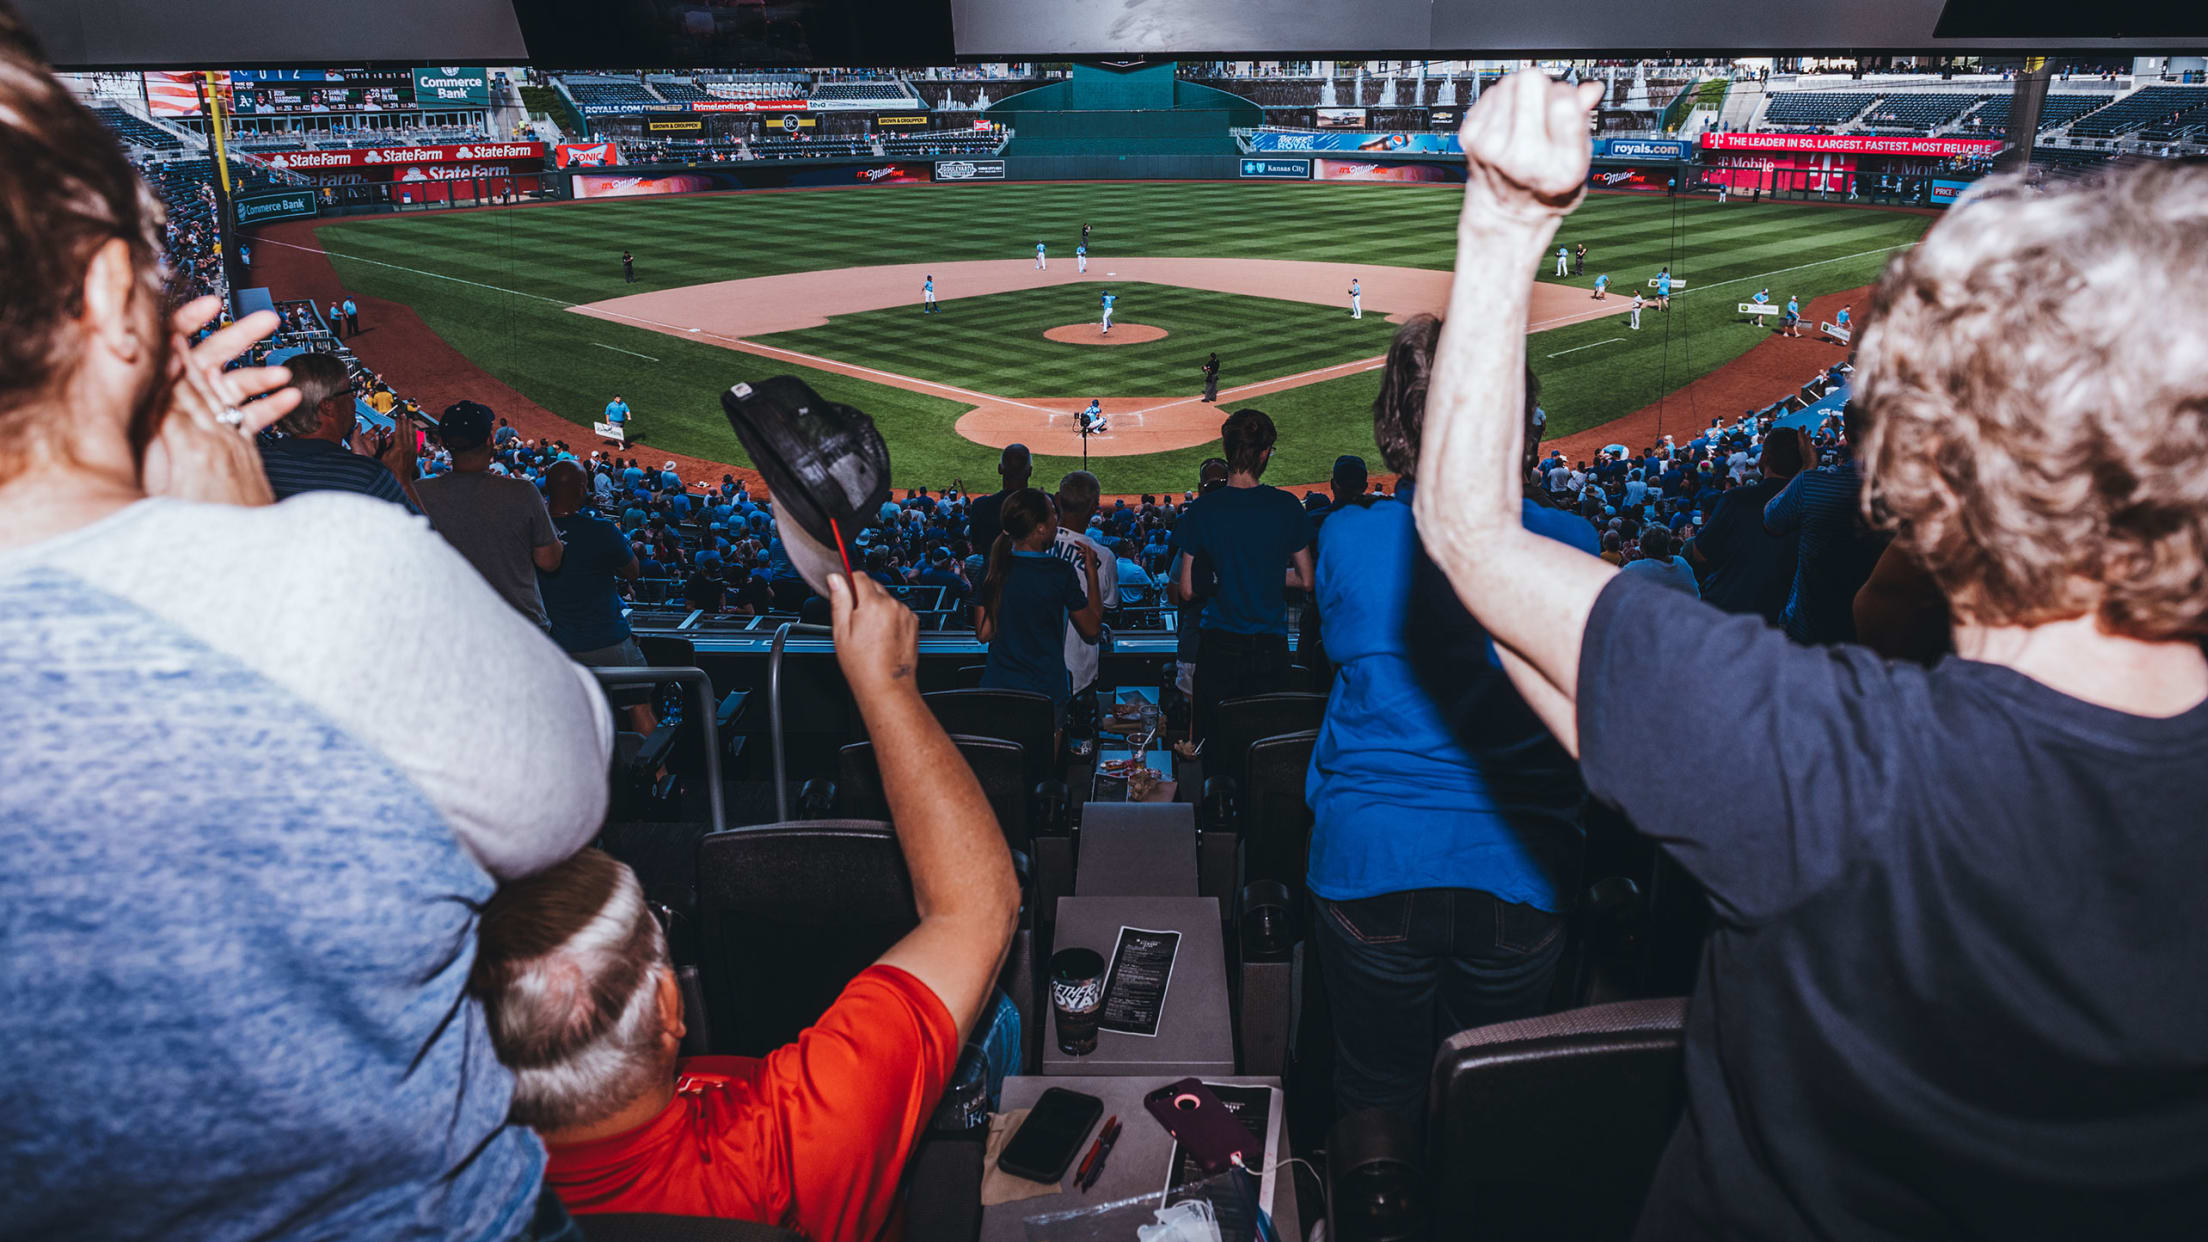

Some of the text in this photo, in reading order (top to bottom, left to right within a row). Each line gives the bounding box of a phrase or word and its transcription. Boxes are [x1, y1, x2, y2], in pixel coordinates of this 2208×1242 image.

[420, 76, 482, 88] Commerce
[438, 88, 467, 98] Bank
[694, 102, 744, 111] PrimeLending
[1614, 142, 1680, 155] royals.com
[1728, 136, 1745, 146] THE
[1748, 137, 1786, 147] LEADER
[1787, 138, 1798, 147] IN
[1800, 138, 1816, 148] 5G.
[1818, 139, 1864, 149] LARGEST.
[1866, 141, 1910, 151] FASTEST.
[1912, 142, 1941, 152] MOST
[571, 152, 602, 162] SONIC
[1292, 164, 1304, 172] City
[1731, 155, 1774, 172] Mobile
[1603, 171, 1635, 186] Miller
[1936, 188, 1953, 196] PRICE
[246, 199, 304, 216] Commerce Bank
